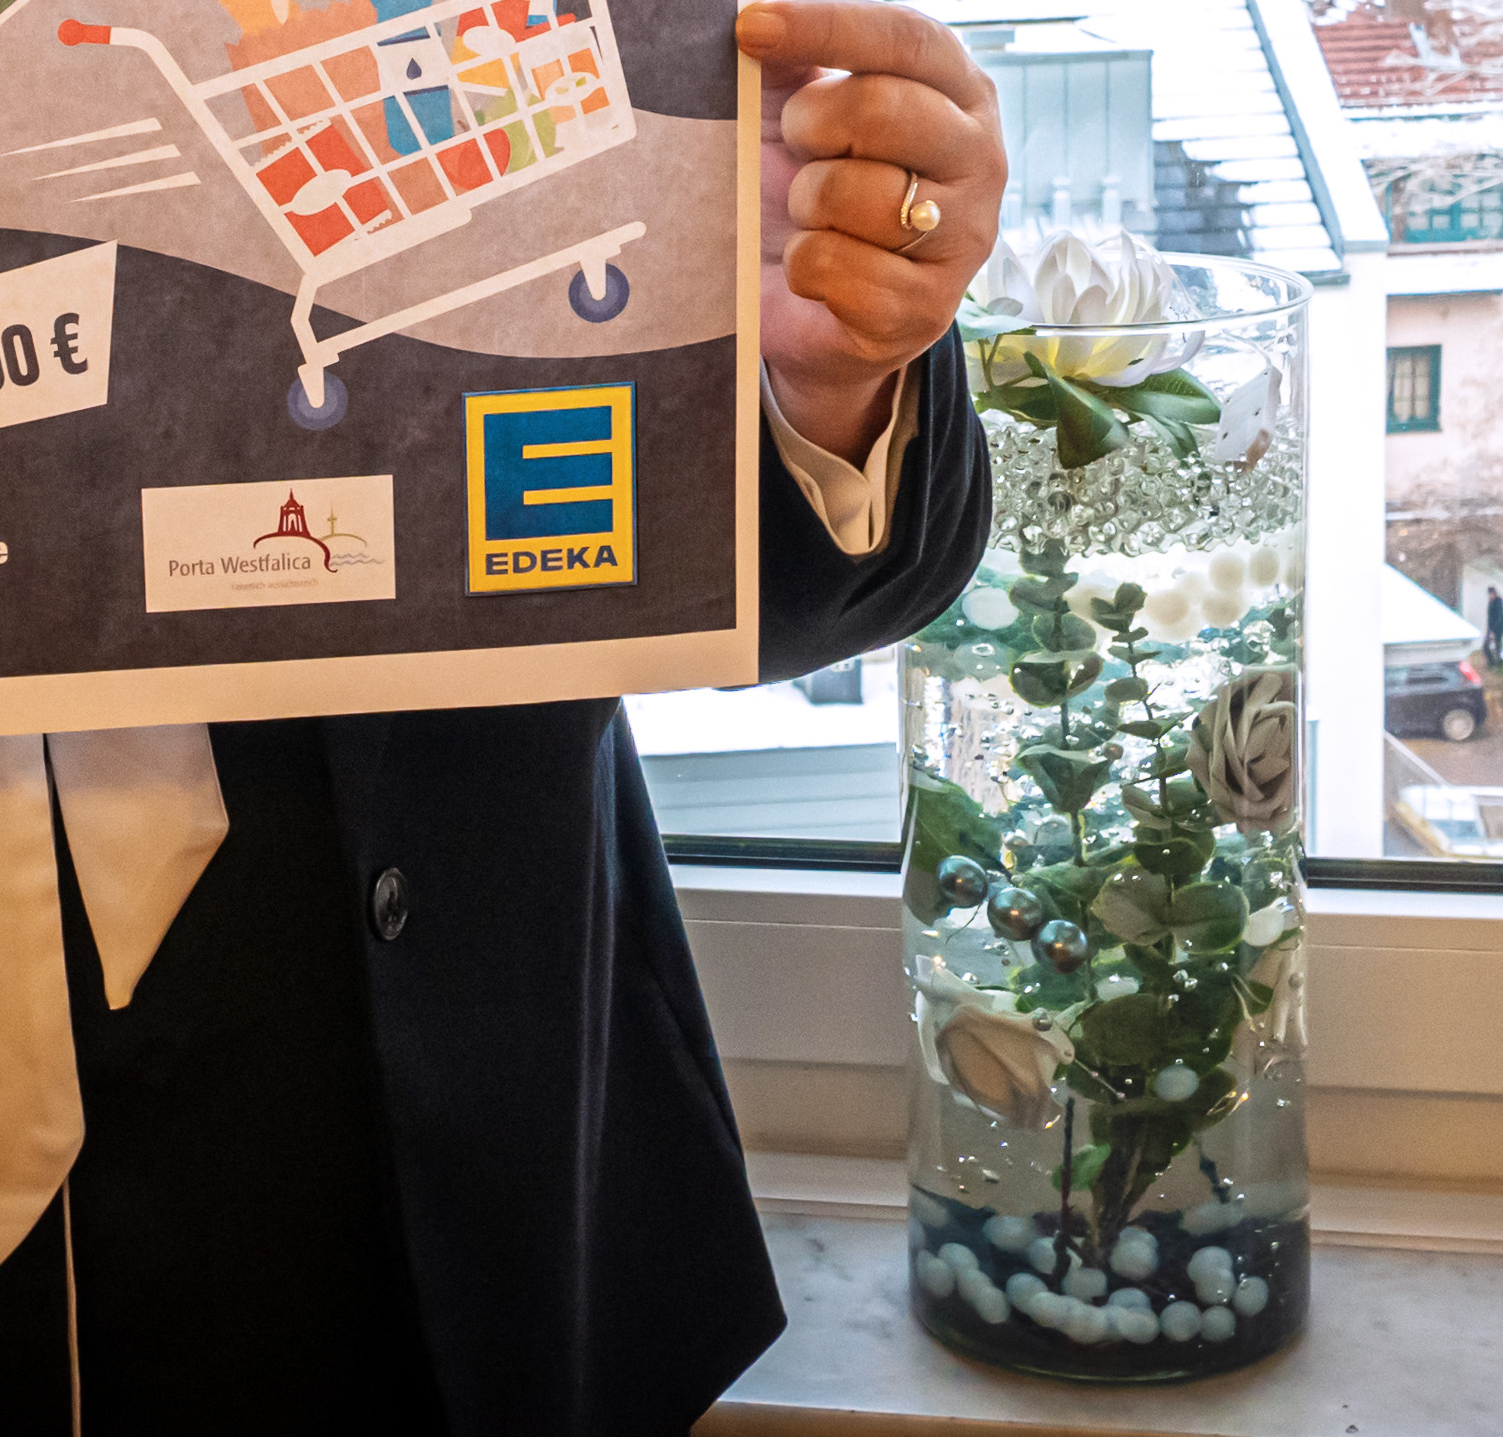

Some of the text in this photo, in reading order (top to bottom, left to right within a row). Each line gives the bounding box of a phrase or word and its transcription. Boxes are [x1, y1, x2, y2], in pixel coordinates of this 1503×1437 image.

[50, 312, 89, 375] €
[169, 552, 311, 577] Porta Westfalica
[485, 544, 618, 576] EDEKA
